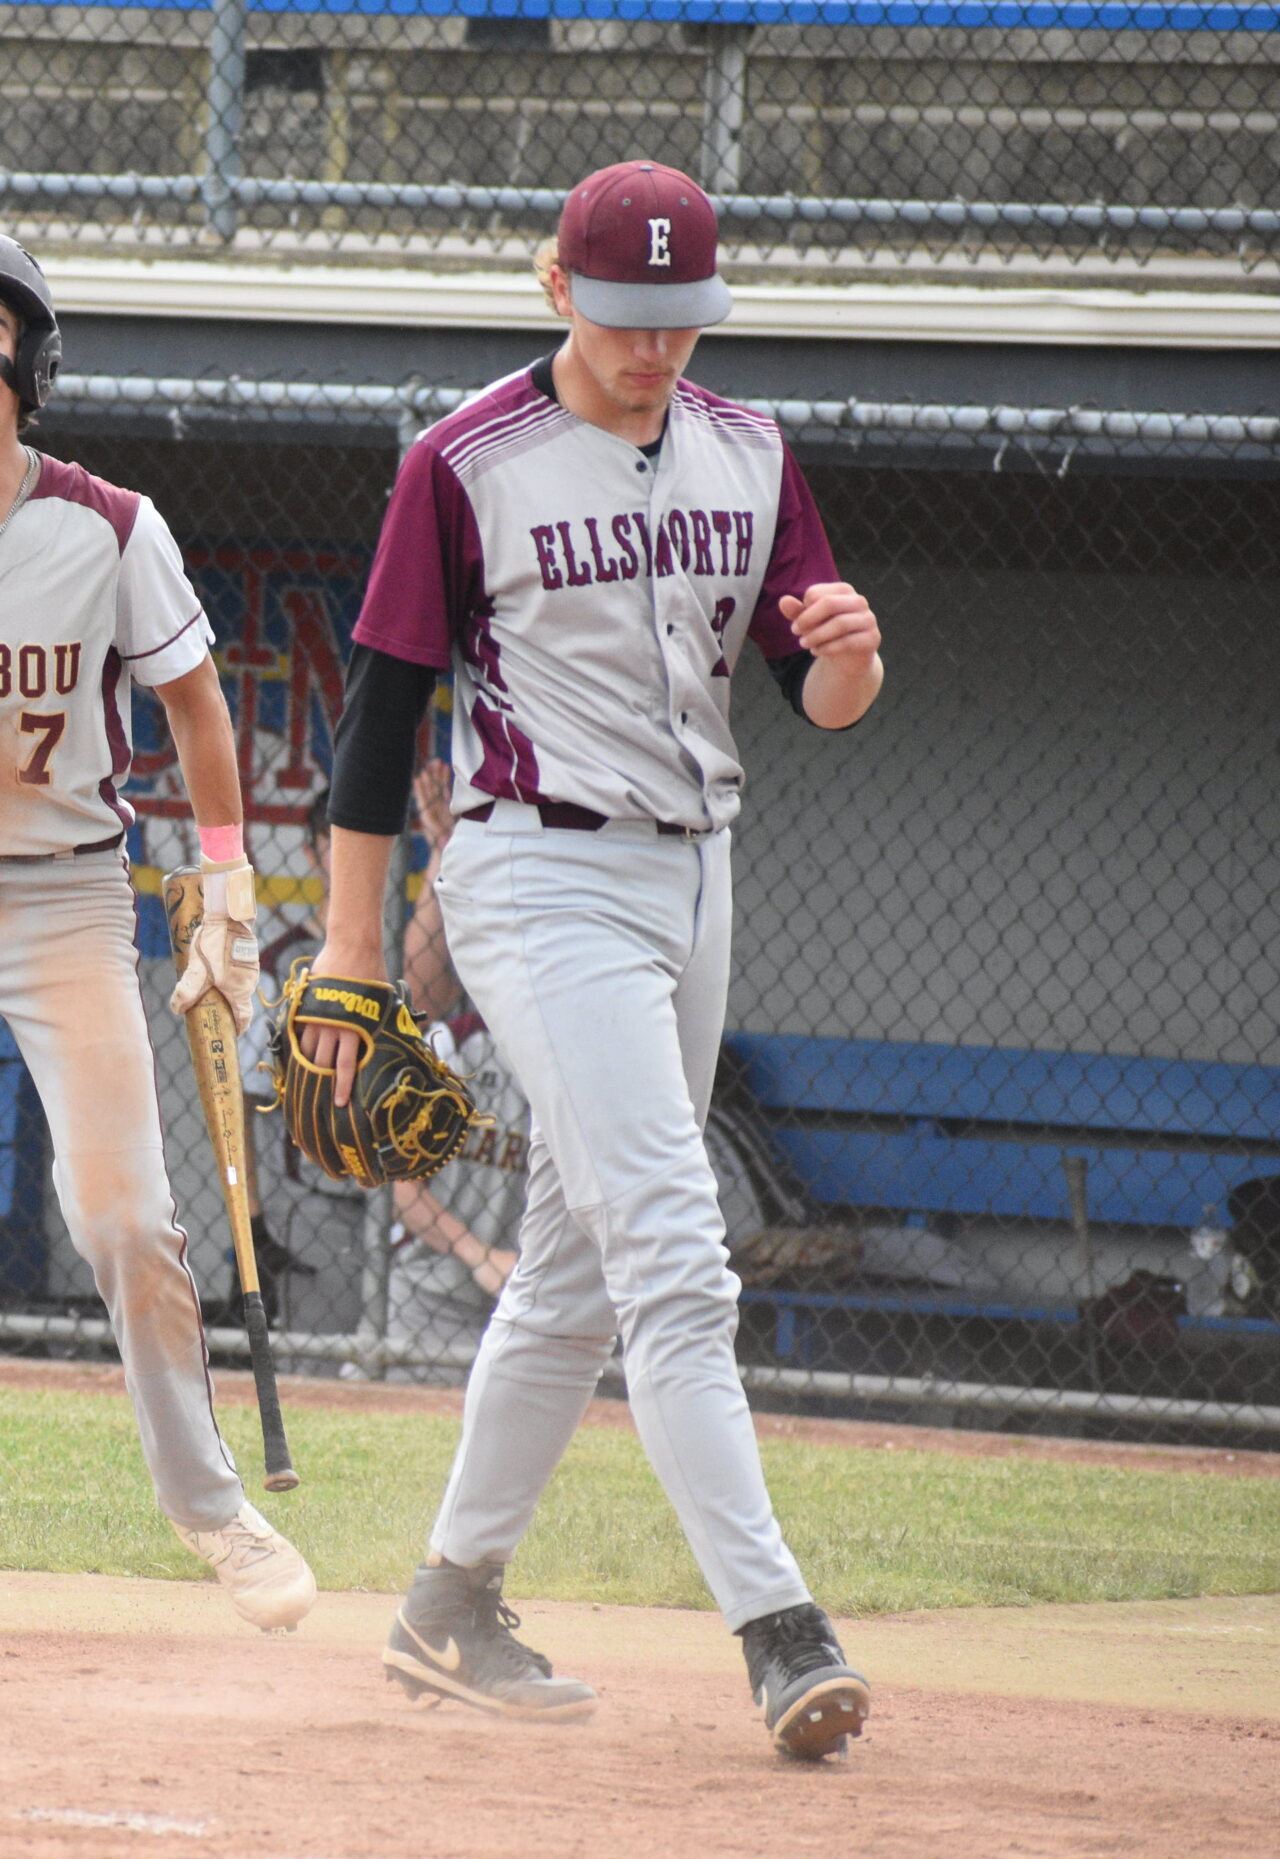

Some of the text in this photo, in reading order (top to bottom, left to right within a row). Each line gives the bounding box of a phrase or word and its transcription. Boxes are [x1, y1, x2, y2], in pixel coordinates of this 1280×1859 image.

[648, 217, 671, 266] E
[530, 509, 754, 591] ELLSWORTH
[18, 710, 67, 786] 7
[312, 986, 381, 1022] Wilson
